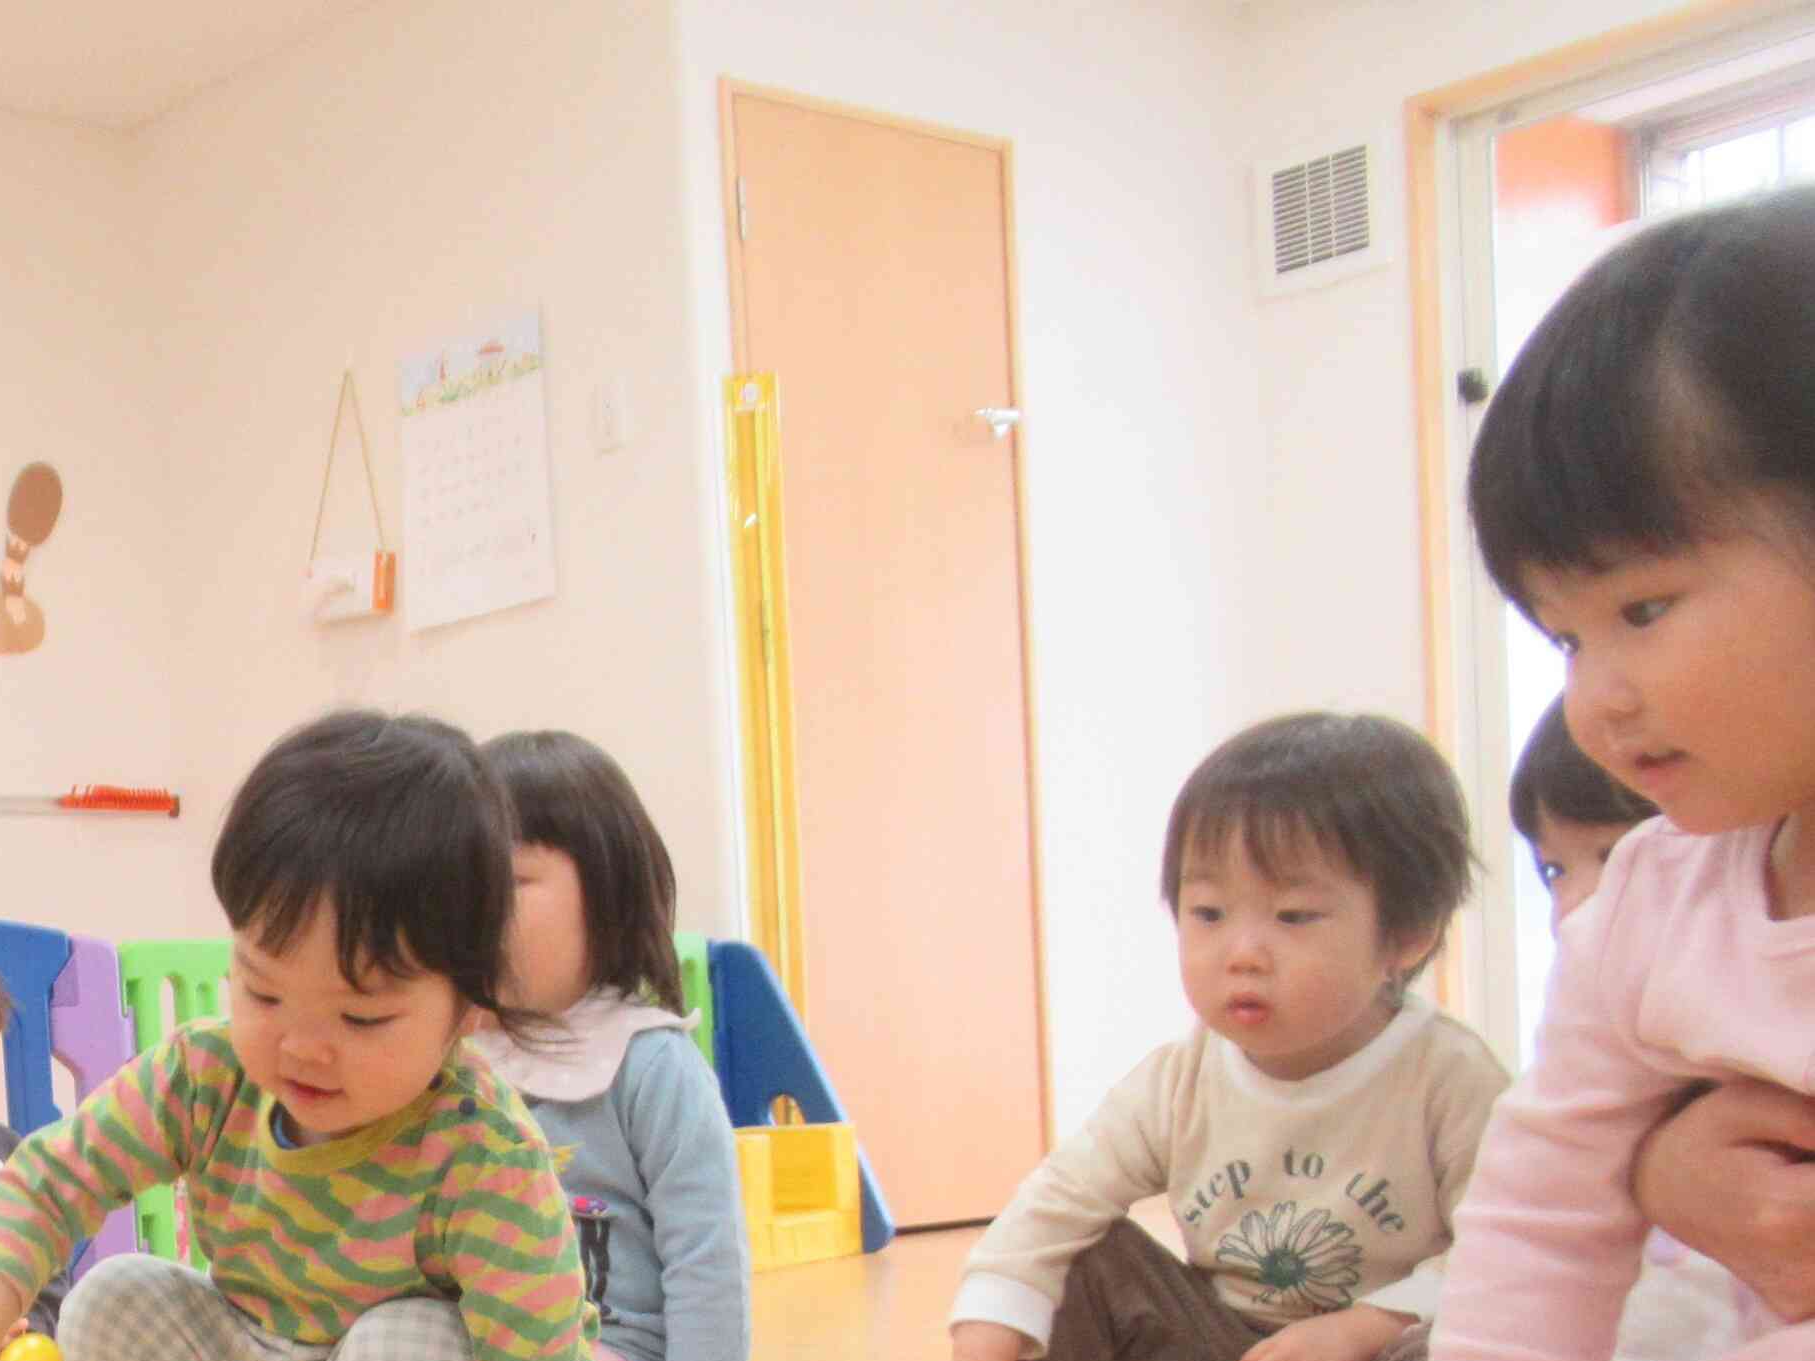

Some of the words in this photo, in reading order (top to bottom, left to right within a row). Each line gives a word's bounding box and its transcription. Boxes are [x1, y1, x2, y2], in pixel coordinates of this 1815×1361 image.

[1185, 1160, 1250, 1225] step
[1282, 1147, 1324, 1179] to
[1345, 1172, 1404, 1232] the
